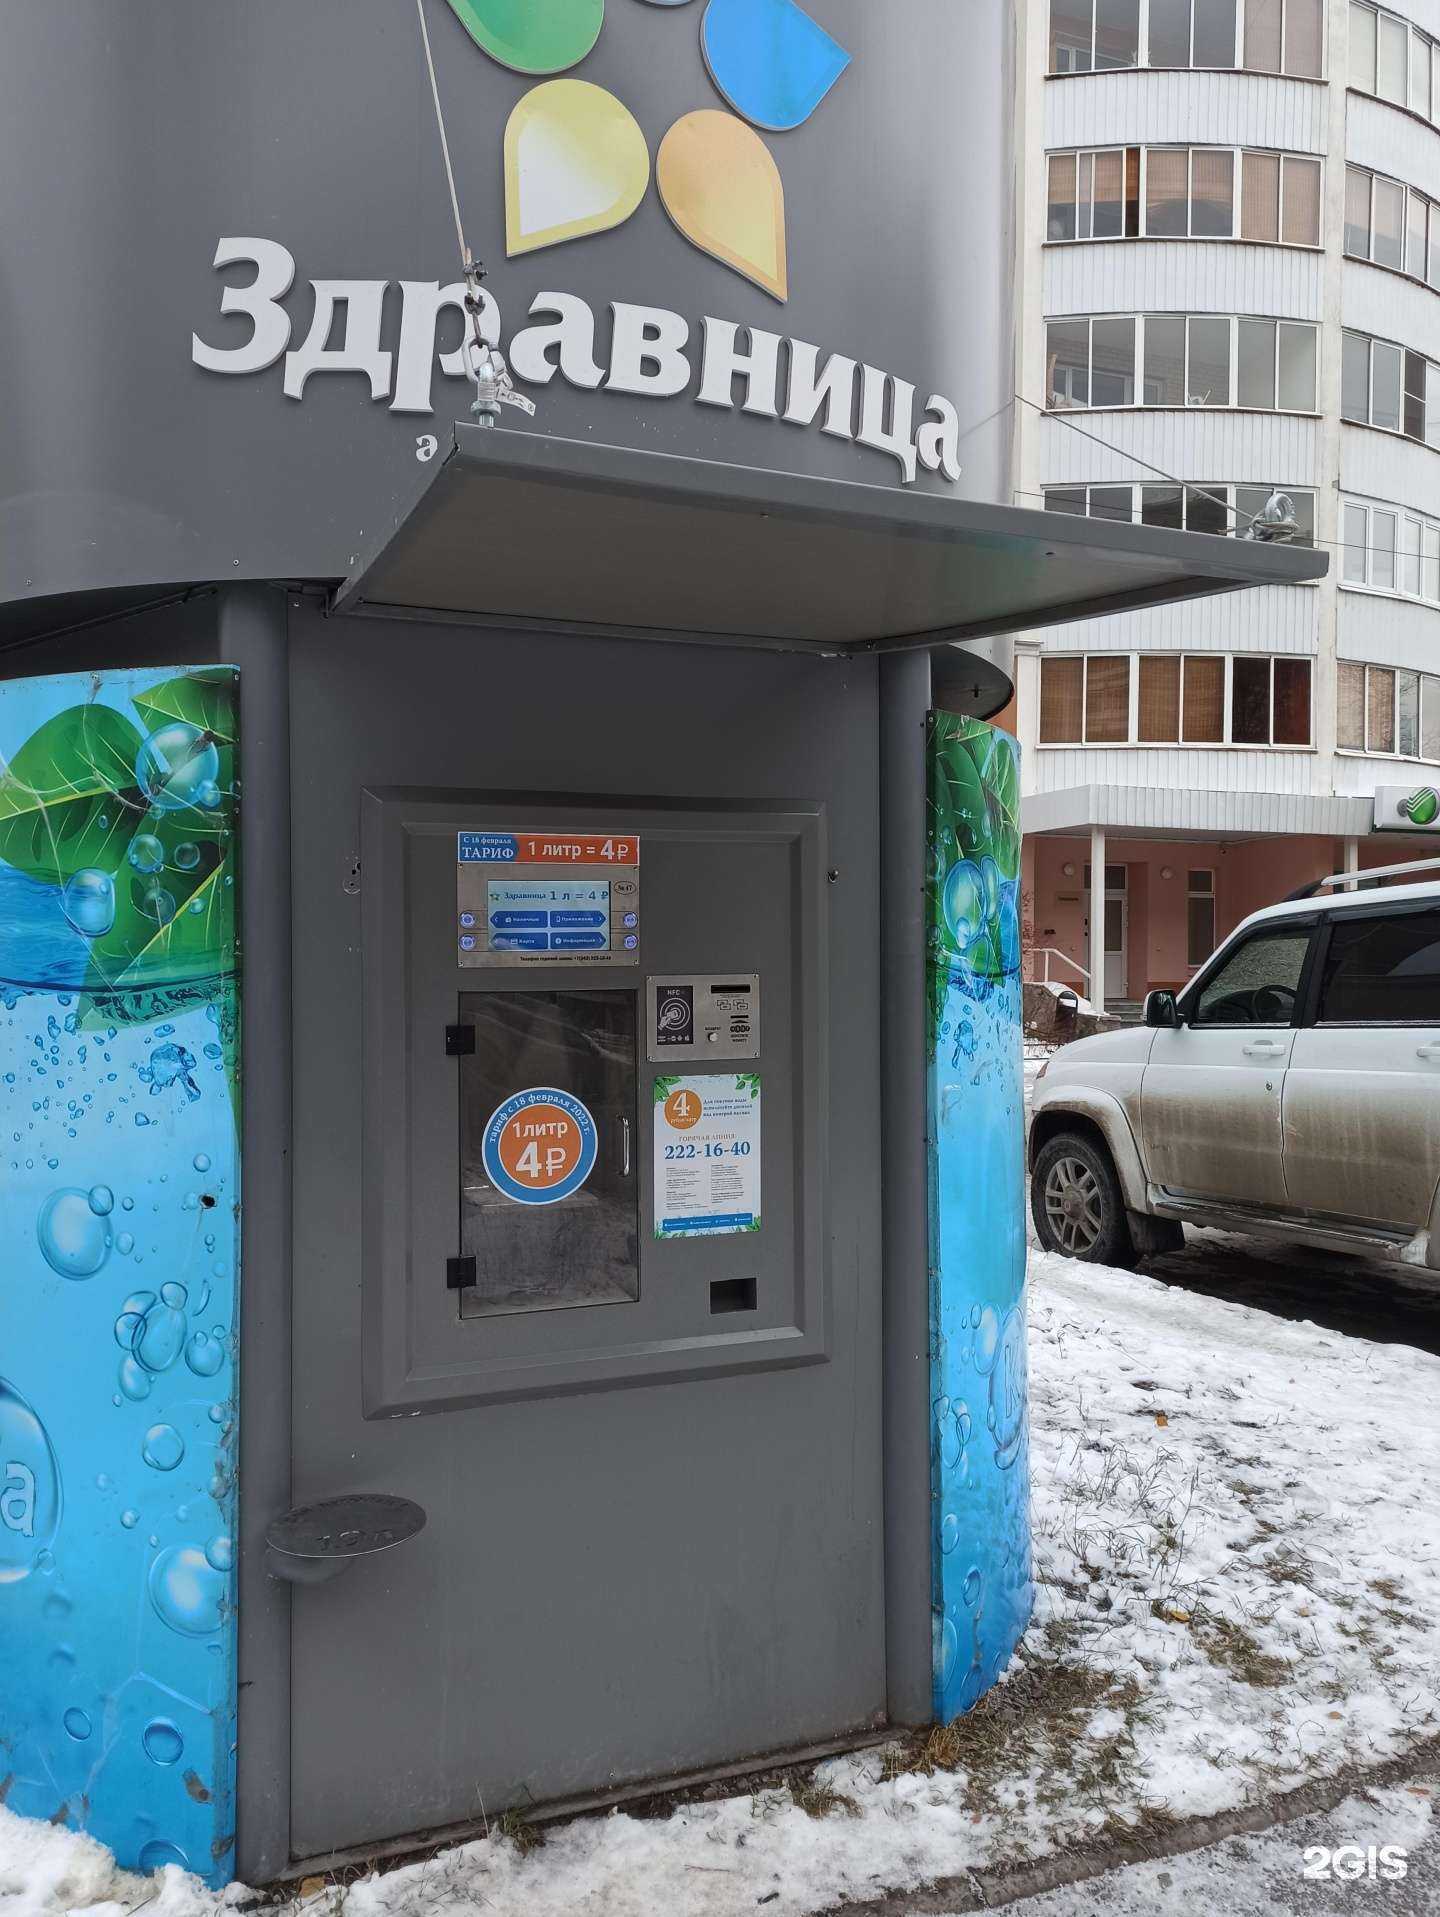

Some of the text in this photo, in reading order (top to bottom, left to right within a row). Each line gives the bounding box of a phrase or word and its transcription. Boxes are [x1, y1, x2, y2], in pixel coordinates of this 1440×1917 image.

[191, 236, 963, 484] Здравница
[463, 836, 470, 844] С
[480, 837, 512, 846] февраля
[462, 847, 514, 859] ТАРИФ
[528, 842, 536, 856] 1
[542, 844, 582, 860] литр
[588, 891, 596, 900] 4
[672, 1092, 690, 1117] 4
[489, 1112, 508, 1143] тариф
[514, 1097, 526, 1109] 18
[528, 1093, 570, 1107] февраля
[570, 1104, 590, 1127] 2022
[679, 1134, 710, 1142] ГОРЯЧАЯ
[664, 1141, 751, 1160] 222-16-40
